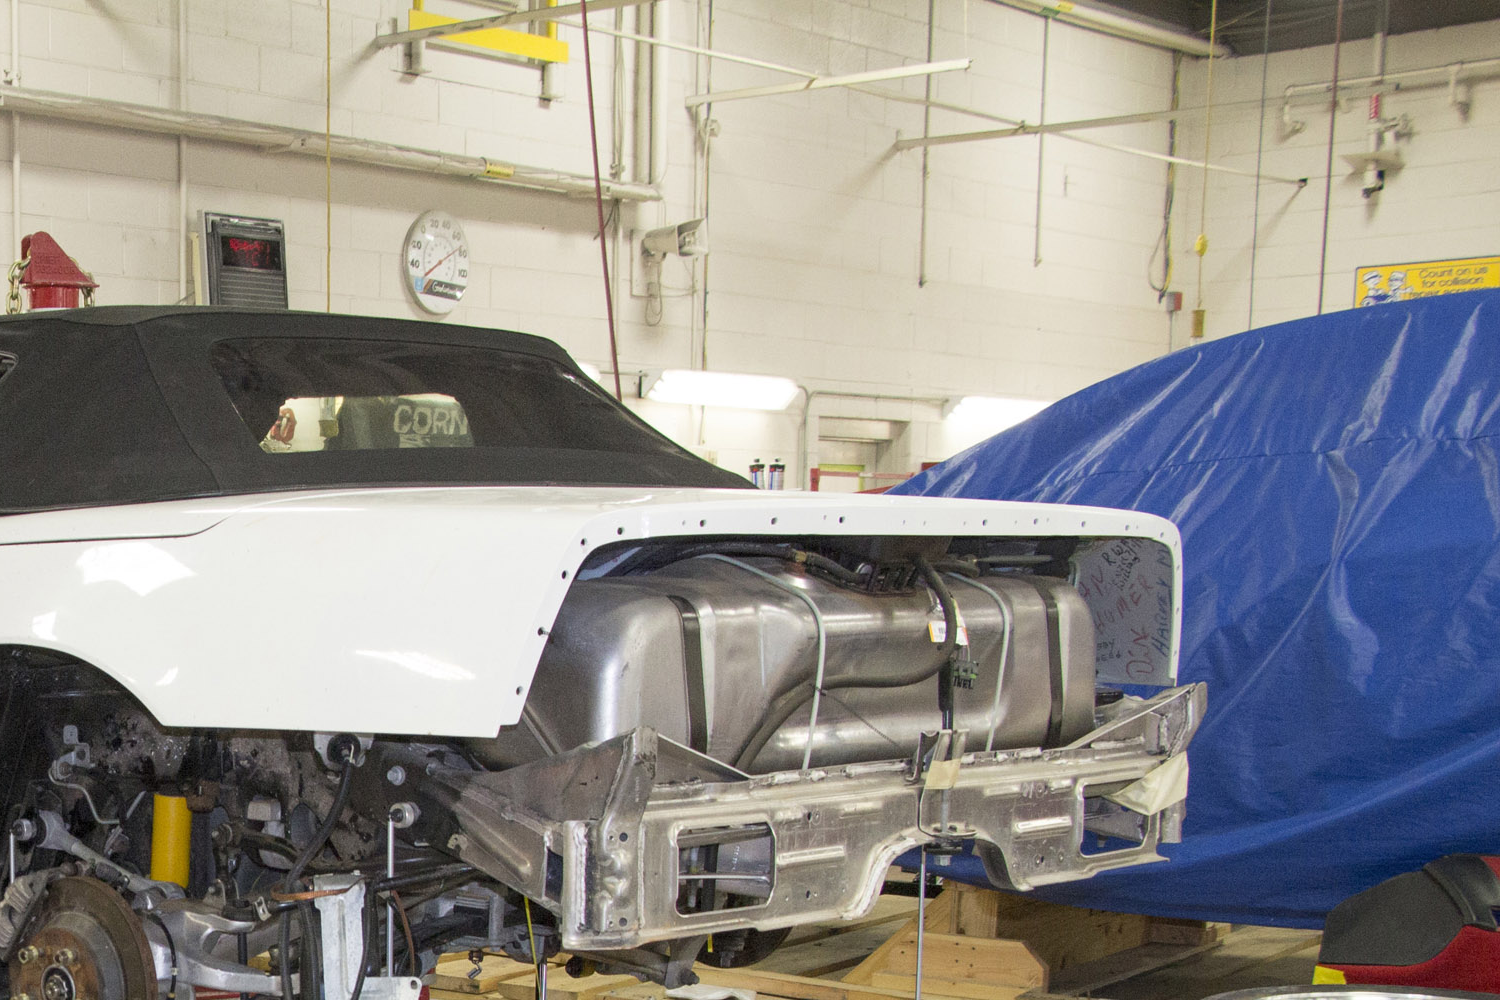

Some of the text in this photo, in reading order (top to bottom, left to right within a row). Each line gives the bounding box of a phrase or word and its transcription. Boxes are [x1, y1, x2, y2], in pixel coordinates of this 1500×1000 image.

[430, 219, 439, 229] 20
[442, 220, 451, 230] 40
[452, 231, 461, 241] 60
[458, 268, 468, 278] 100
[1419, 266, 1488, 279] Count on us
[1422, 276, 1485, 288] for collision
